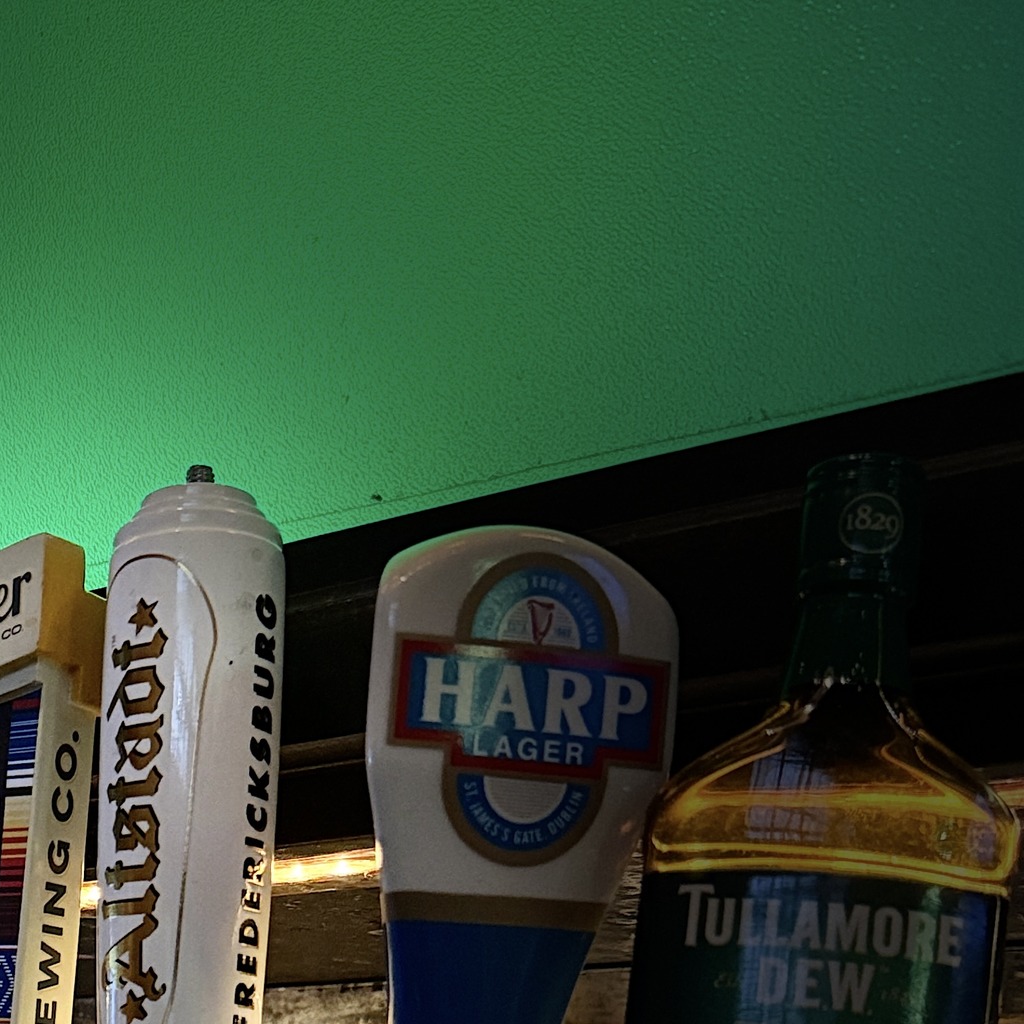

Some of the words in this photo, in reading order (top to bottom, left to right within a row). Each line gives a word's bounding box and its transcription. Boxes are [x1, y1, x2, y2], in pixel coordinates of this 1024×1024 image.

[845, 503, 898, 540] 1829
[1, 624, 22, 640] CO
[419, 655, 649, 741] HARP
[51, 730, 80, 823] CO.
[473, 733, 584, 766] LAGER
[676, 883, 965, 968] TULLAMORE
